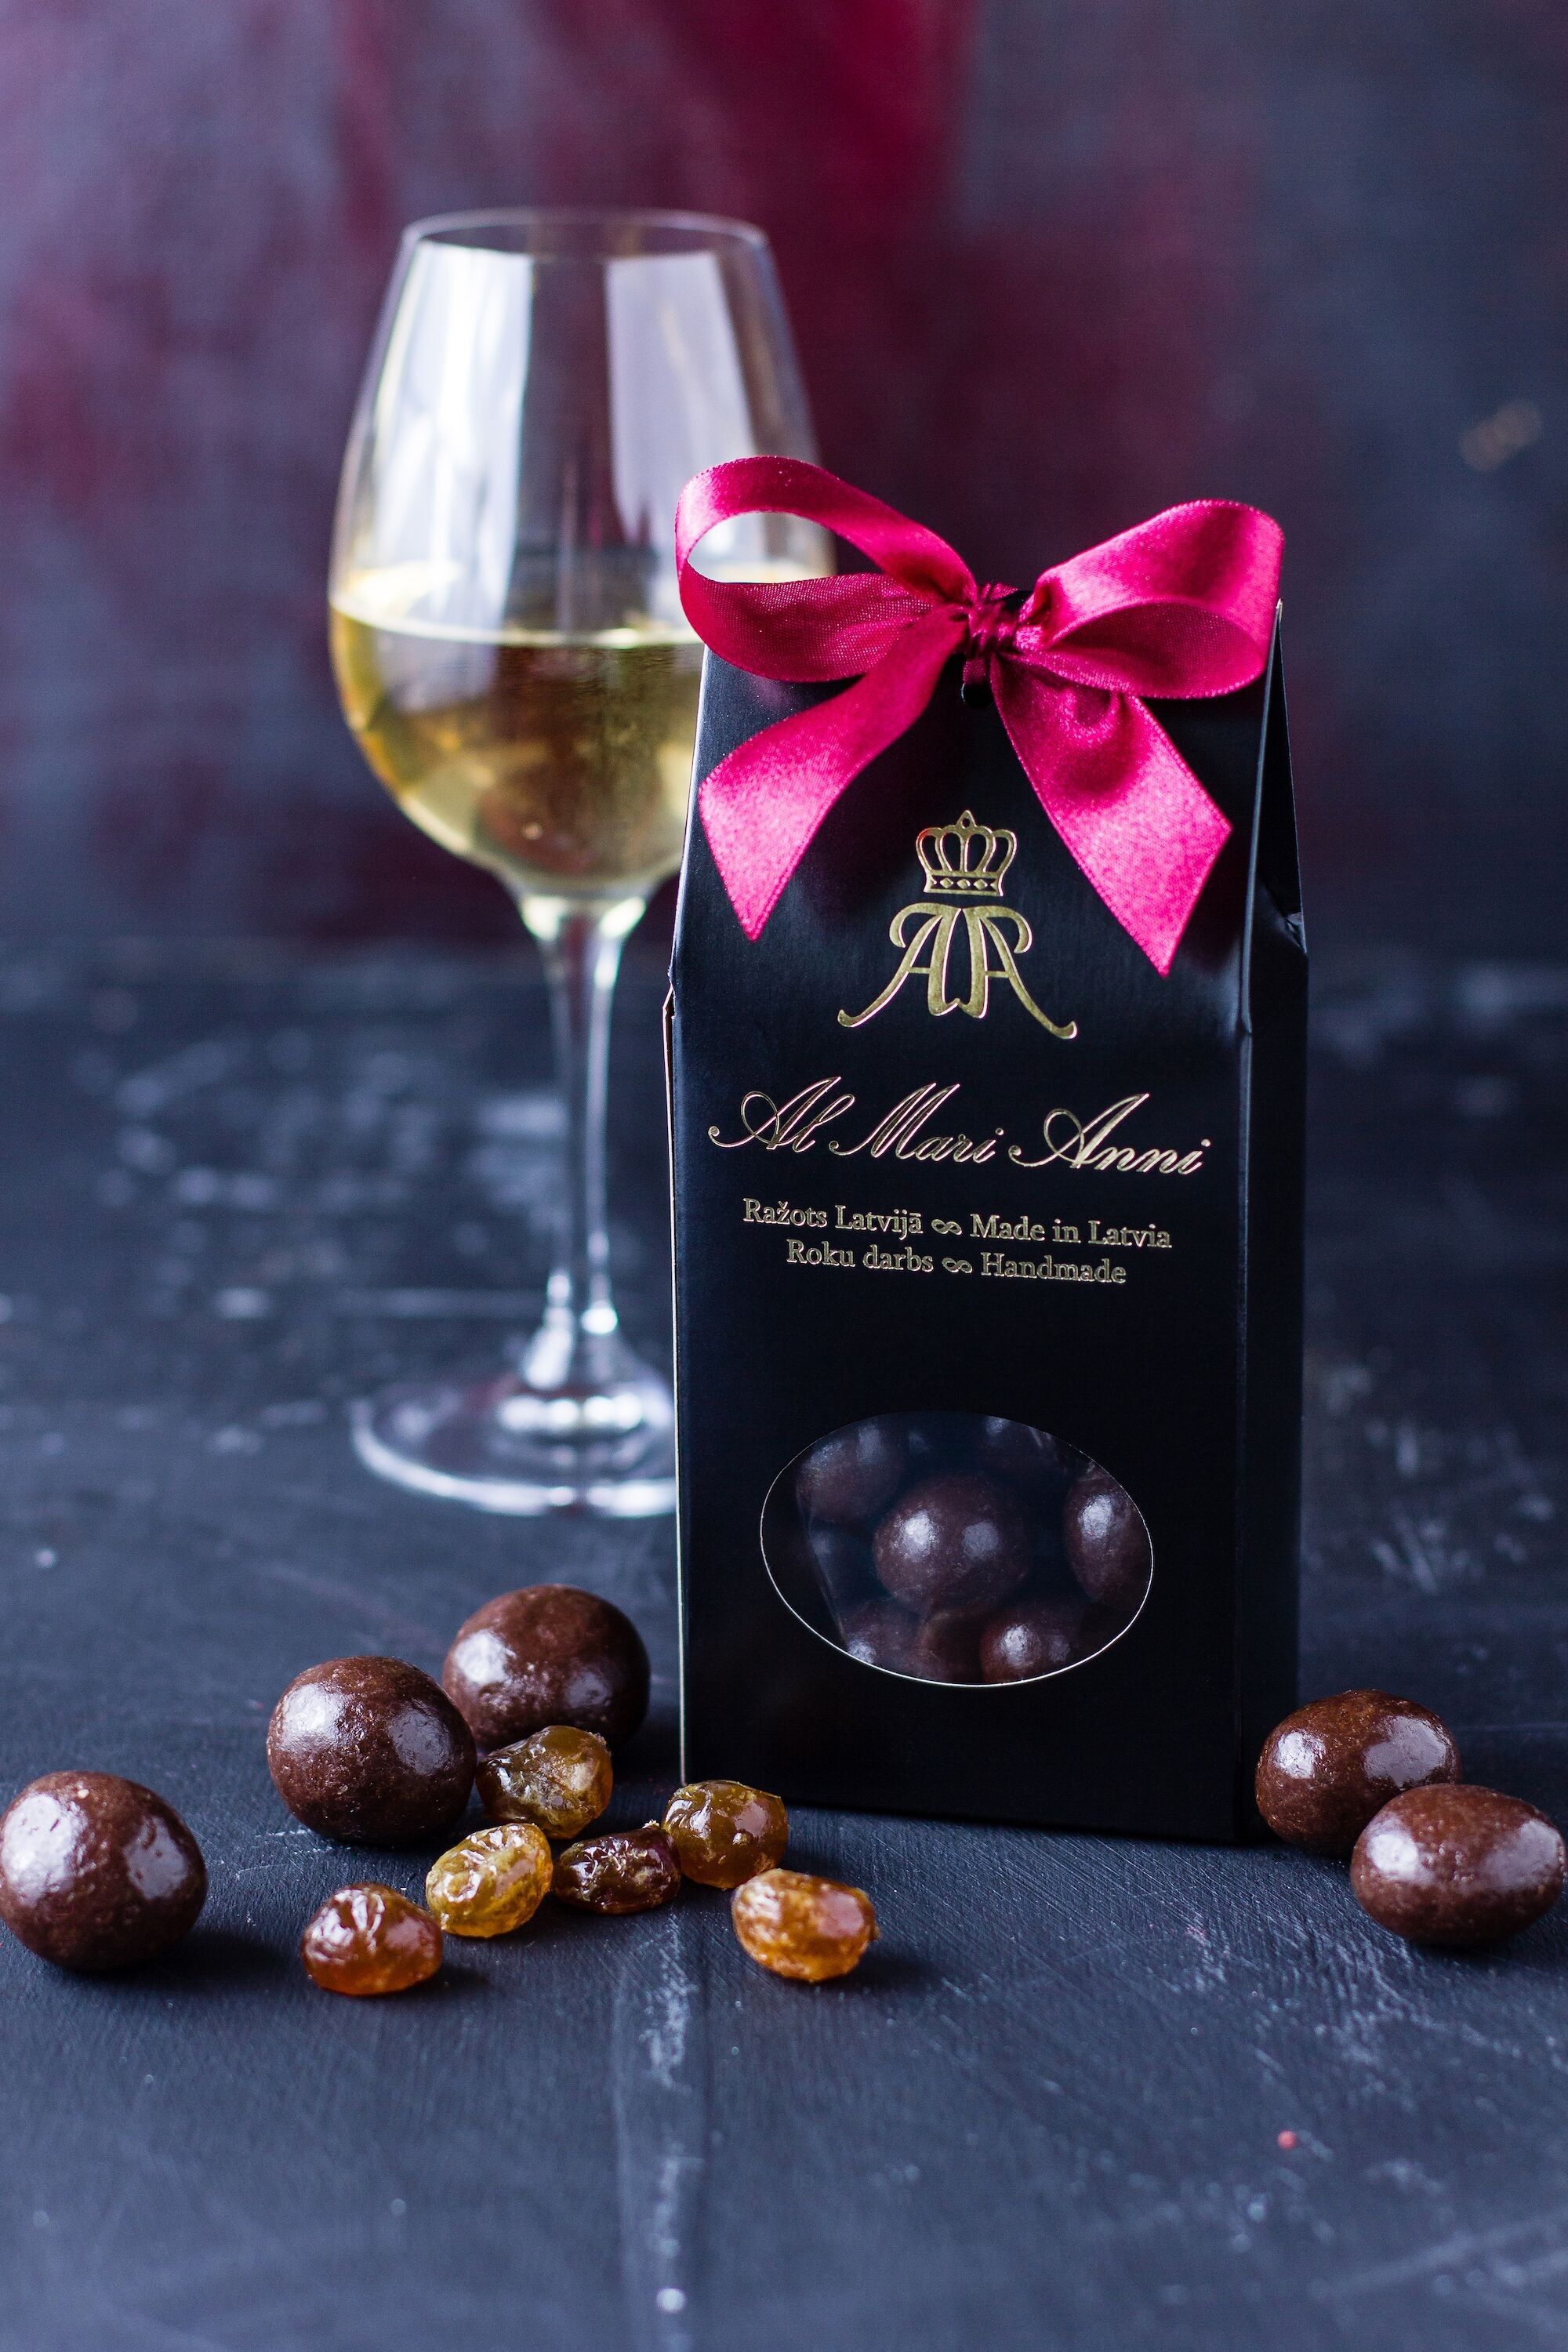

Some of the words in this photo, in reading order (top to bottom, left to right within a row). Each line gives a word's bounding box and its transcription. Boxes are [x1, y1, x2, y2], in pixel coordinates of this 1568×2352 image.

[708, 1076, 855, 1153] Al
[828, 1083, 1004, 1164] Mari
[1008, 1094, 1211, 1175] Anni
[742, 1197, 828, 1229] Ražots
[834, 1204, 924, 1240] Latvijā
[969, 1214, 1046, 1242] Made
[1051, 1218, 1082, 1243] in
[1087, 1220, 1173, 1249] Latvia
[786, 1239, 856, 1268] Roku
[862, 1243, 935, 1273] darbs
[980, 1252, 1127, 1284] Handmade
